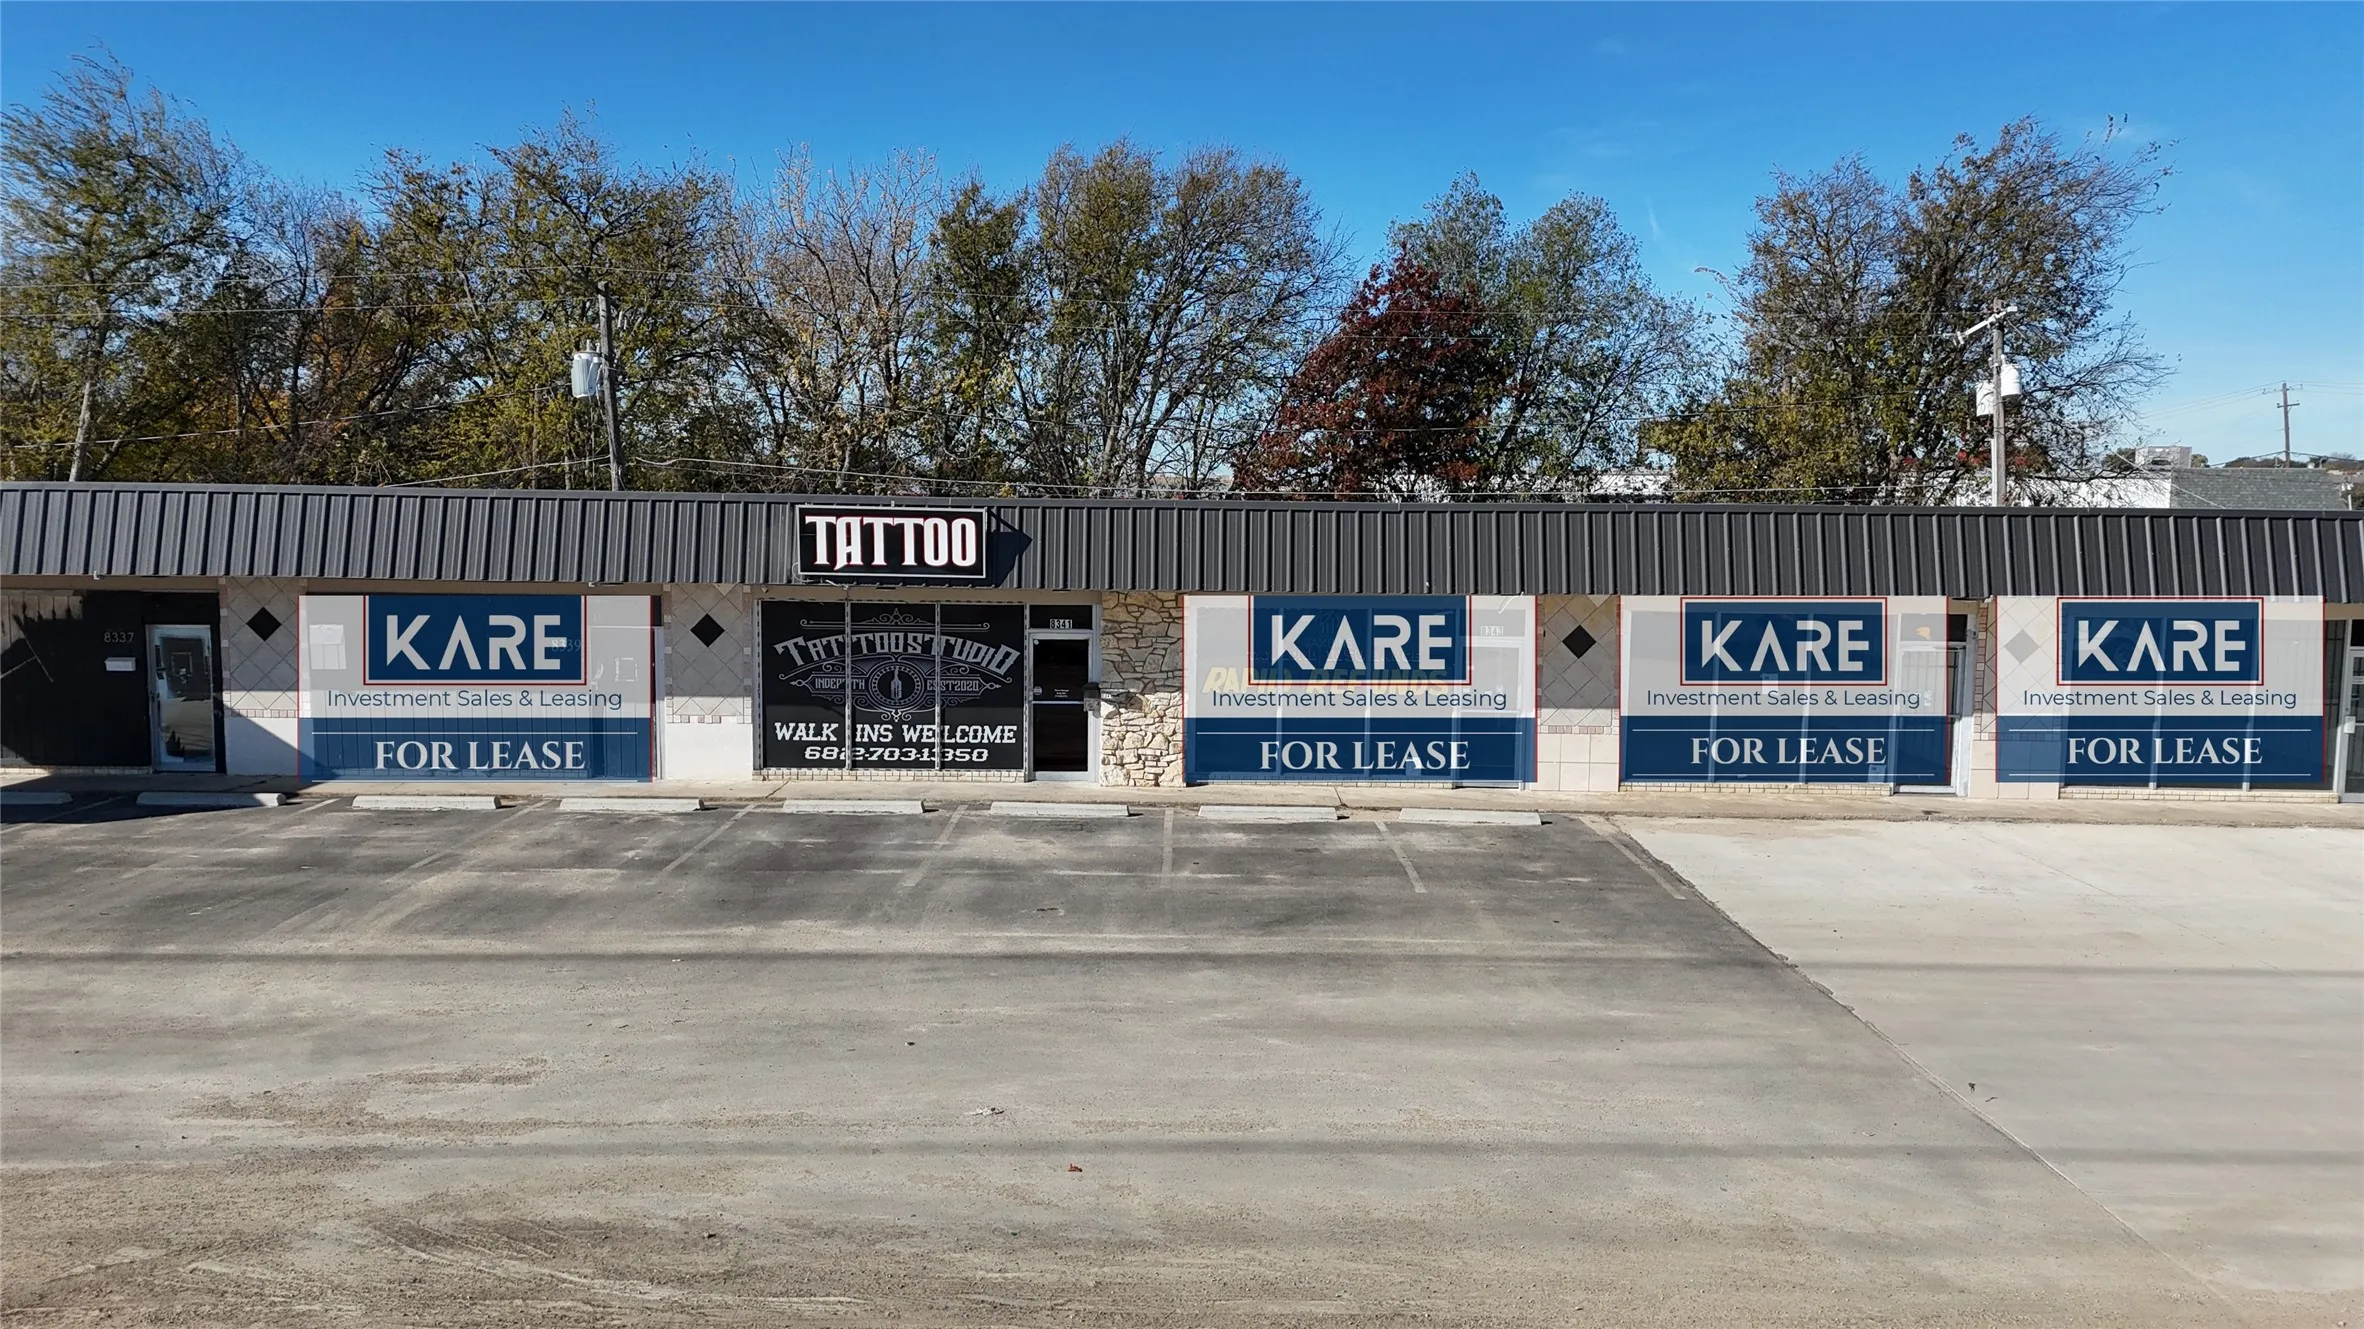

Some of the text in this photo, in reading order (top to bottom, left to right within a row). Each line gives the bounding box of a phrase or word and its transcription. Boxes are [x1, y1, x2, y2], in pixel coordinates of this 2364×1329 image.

[805, 515, 977, 571] TATTOO
[1050, 619, 1072, 630] 8341
[104, 632, 134, 643] 8337
[775, 722, 1017, 744] WALK INS WELCOME
